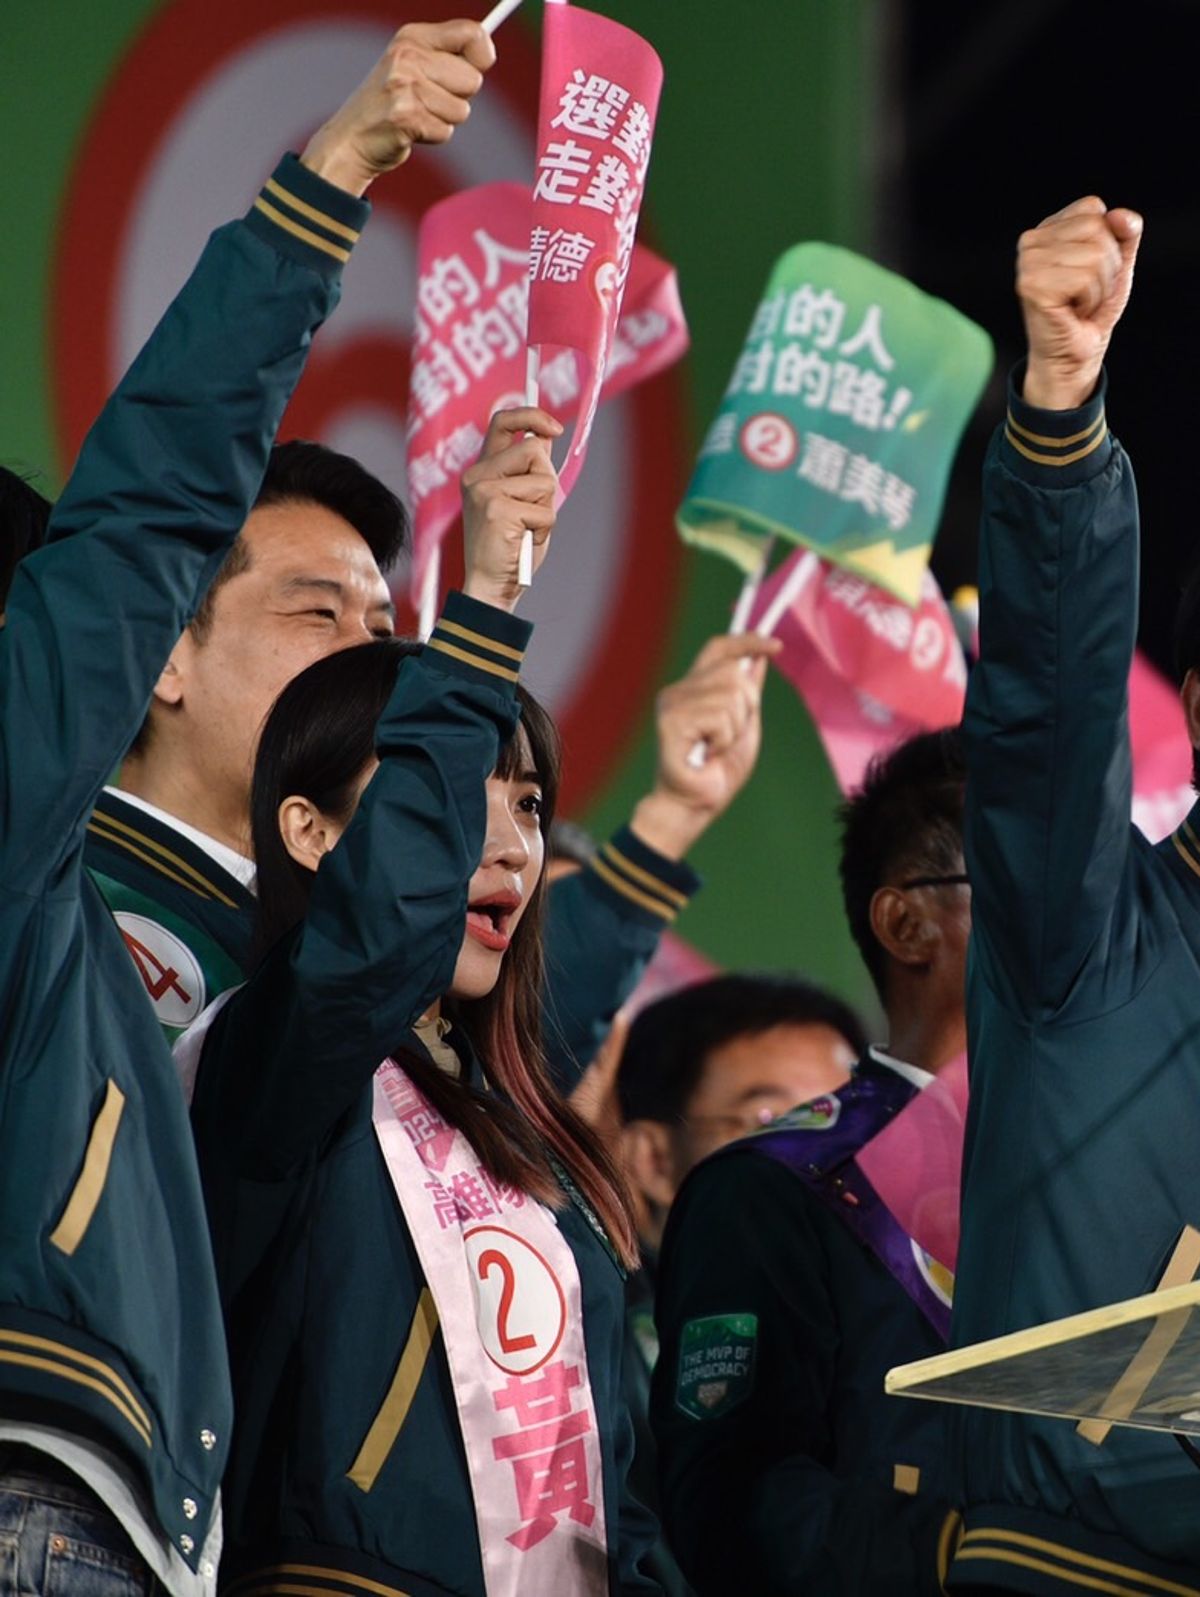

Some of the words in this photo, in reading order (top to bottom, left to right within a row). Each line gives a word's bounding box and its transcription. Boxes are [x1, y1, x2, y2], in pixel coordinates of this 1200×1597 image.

[417, 229, 531, 343] 的人
[478, 1249, 538, 1354] 2
[491, 1359, 597, 1552] 黃
